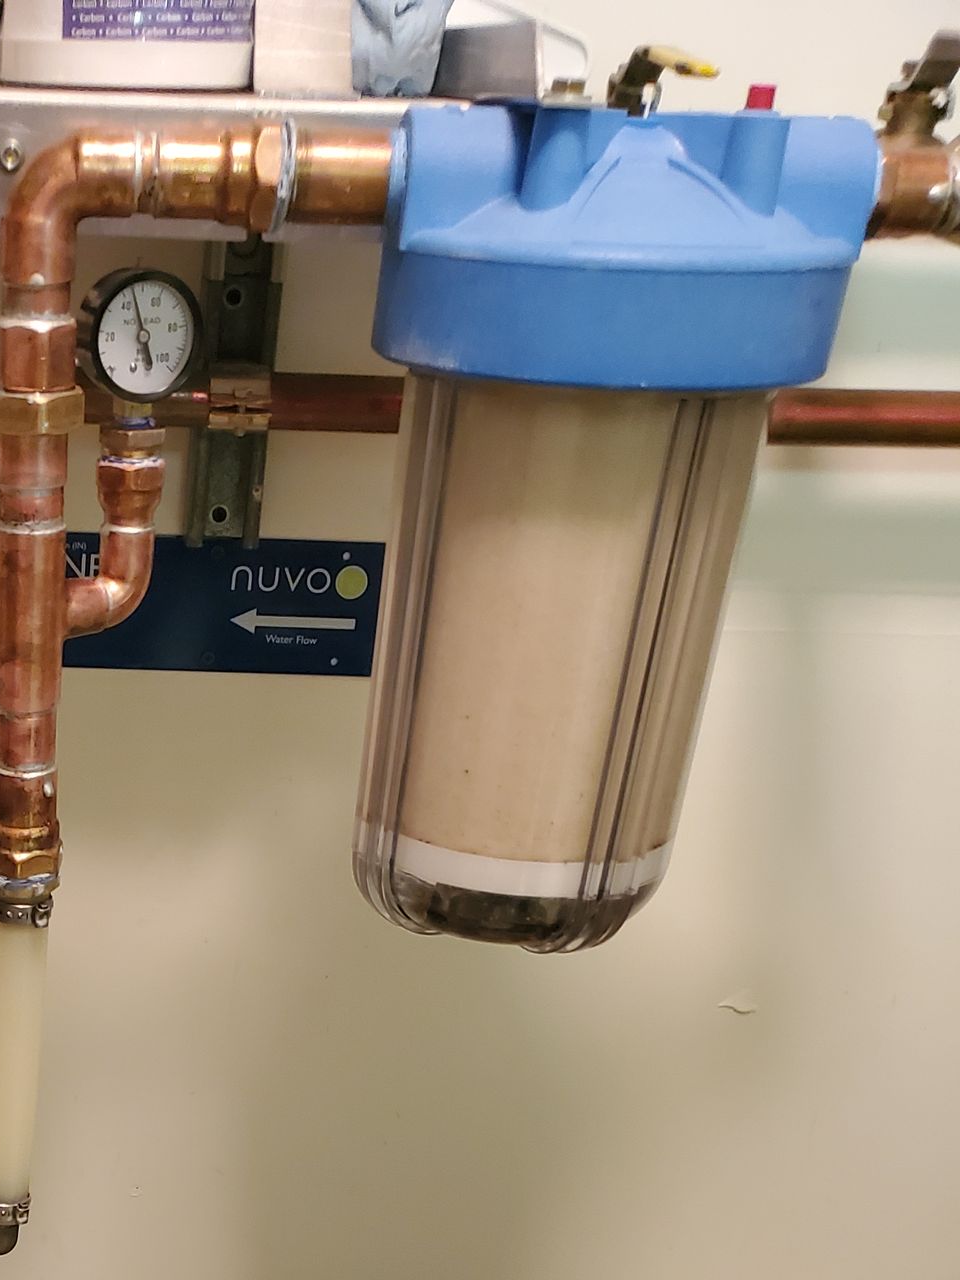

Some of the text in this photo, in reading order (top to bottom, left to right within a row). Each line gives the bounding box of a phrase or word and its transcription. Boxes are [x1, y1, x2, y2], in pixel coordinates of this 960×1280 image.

[80, 12, 104, 22] Carbon
[156, 12, 181, 22] Carbon
[71, 26, 97, 37] Carbon
[106, 26, 132, 37] Carbon
[121, 301, 131, 310] 40
[105, 331, 115, 342] 20
[156, 353, 170, 363] 100
[266, 634, 317, 645] Water Flow
